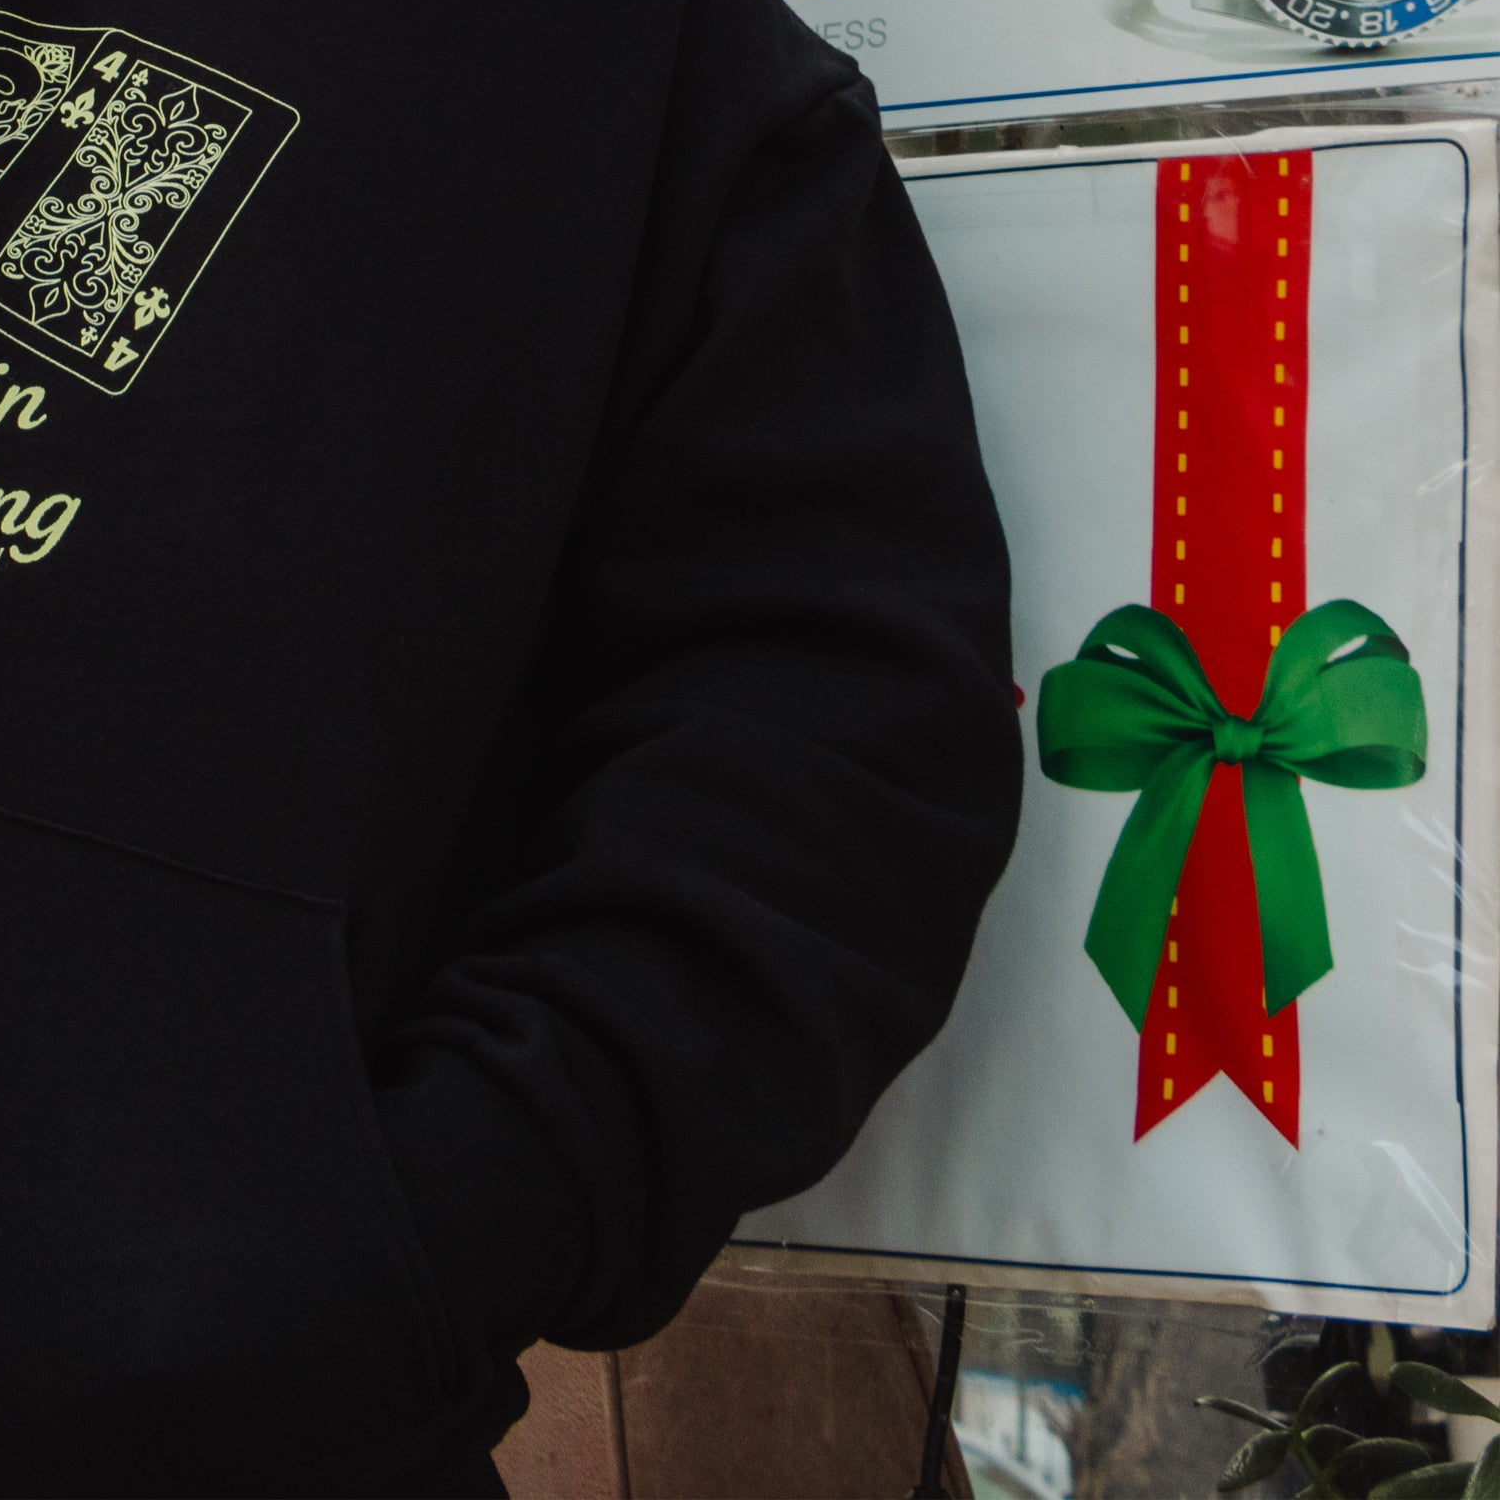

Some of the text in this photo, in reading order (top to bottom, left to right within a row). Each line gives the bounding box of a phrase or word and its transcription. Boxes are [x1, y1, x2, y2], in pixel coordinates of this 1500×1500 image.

[1359, 10, 1399, 35] 18
[93, 51, 127, 82] 4
[103, 337, 139, 371] 4
